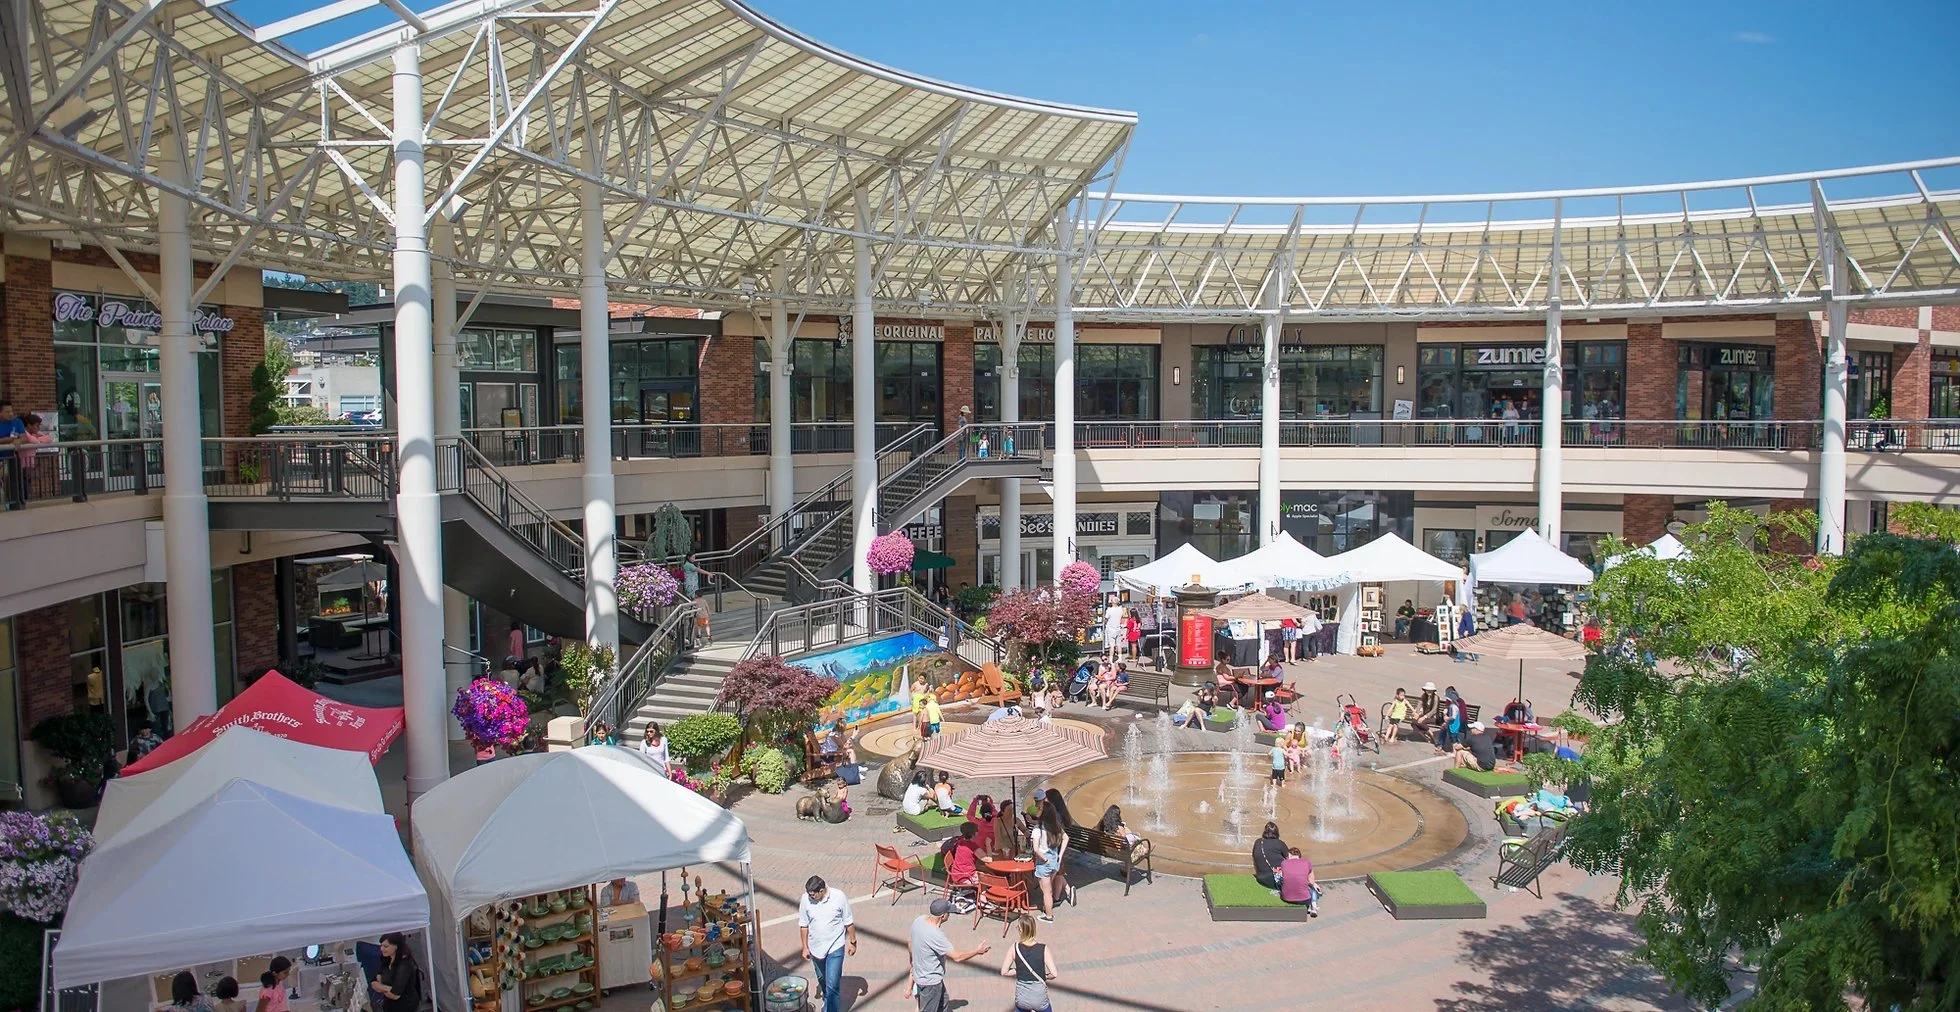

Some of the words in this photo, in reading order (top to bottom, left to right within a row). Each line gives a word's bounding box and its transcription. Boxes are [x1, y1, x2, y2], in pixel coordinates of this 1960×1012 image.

[55, 293, 92, 322] The
[99, 302, 162, 327] Painte
[883, 326, 944, 339] ORIGINAL
[1477, 347, 1546, 364] zumie
[1076, 521, 1115, 532] NDIES
[212, 714, 250, 737] Smith
[250, 710, 303, 728] Brothers
